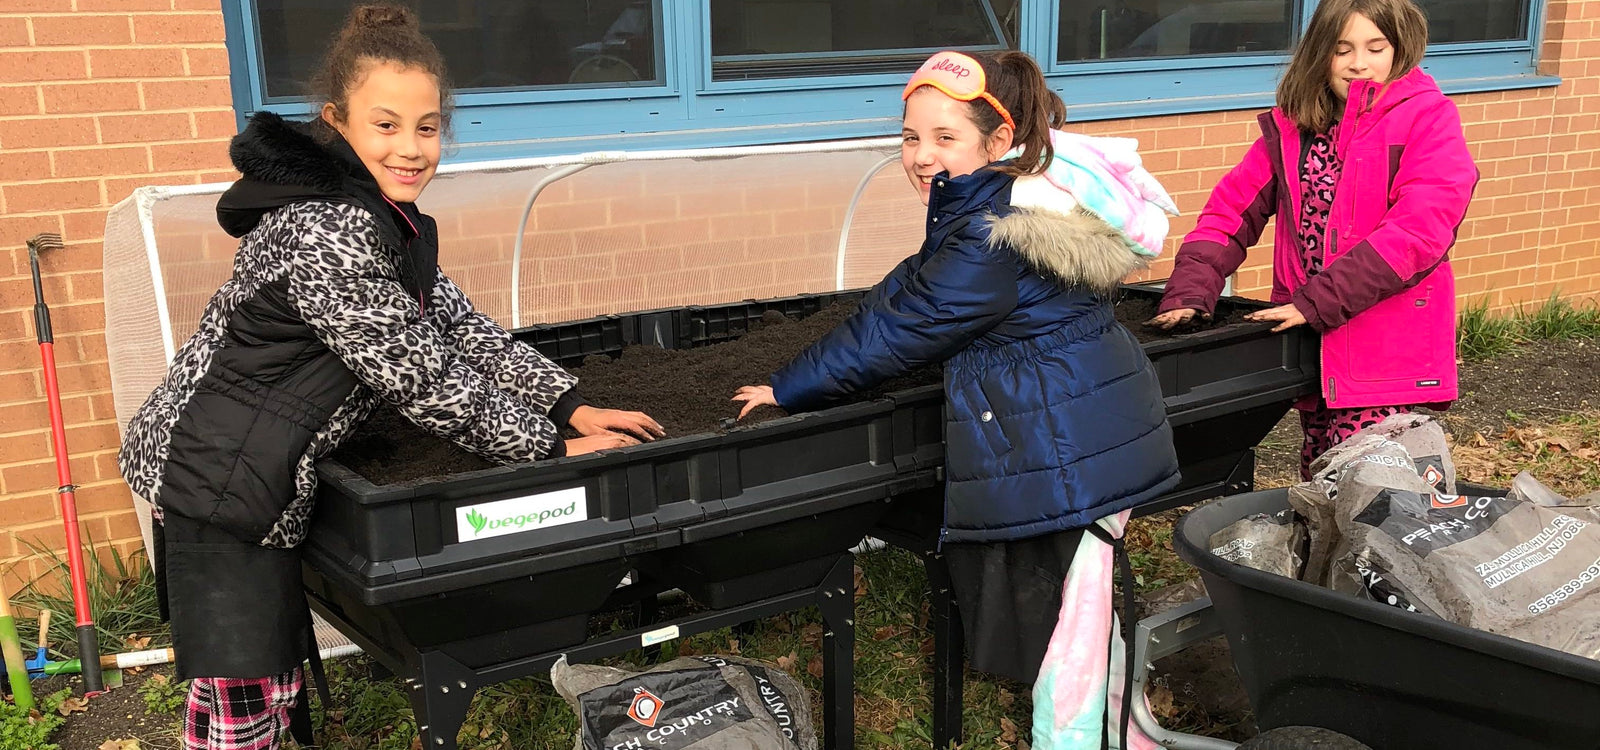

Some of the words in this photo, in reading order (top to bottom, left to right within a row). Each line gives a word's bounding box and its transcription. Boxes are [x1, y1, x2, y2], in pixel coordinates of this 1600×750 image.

[931, 58, 971, 79] sleep
[488, 501, 577, 529] vegepod
[1401, 518, 1465, 546] PEACH
[1532, 527, 1558, 548] HILL
[1484, 558, 1530, 588] MULLICA
[1546, 538, 1567, 555] NJ
[646, 697, 739, 742] COUNTRY
